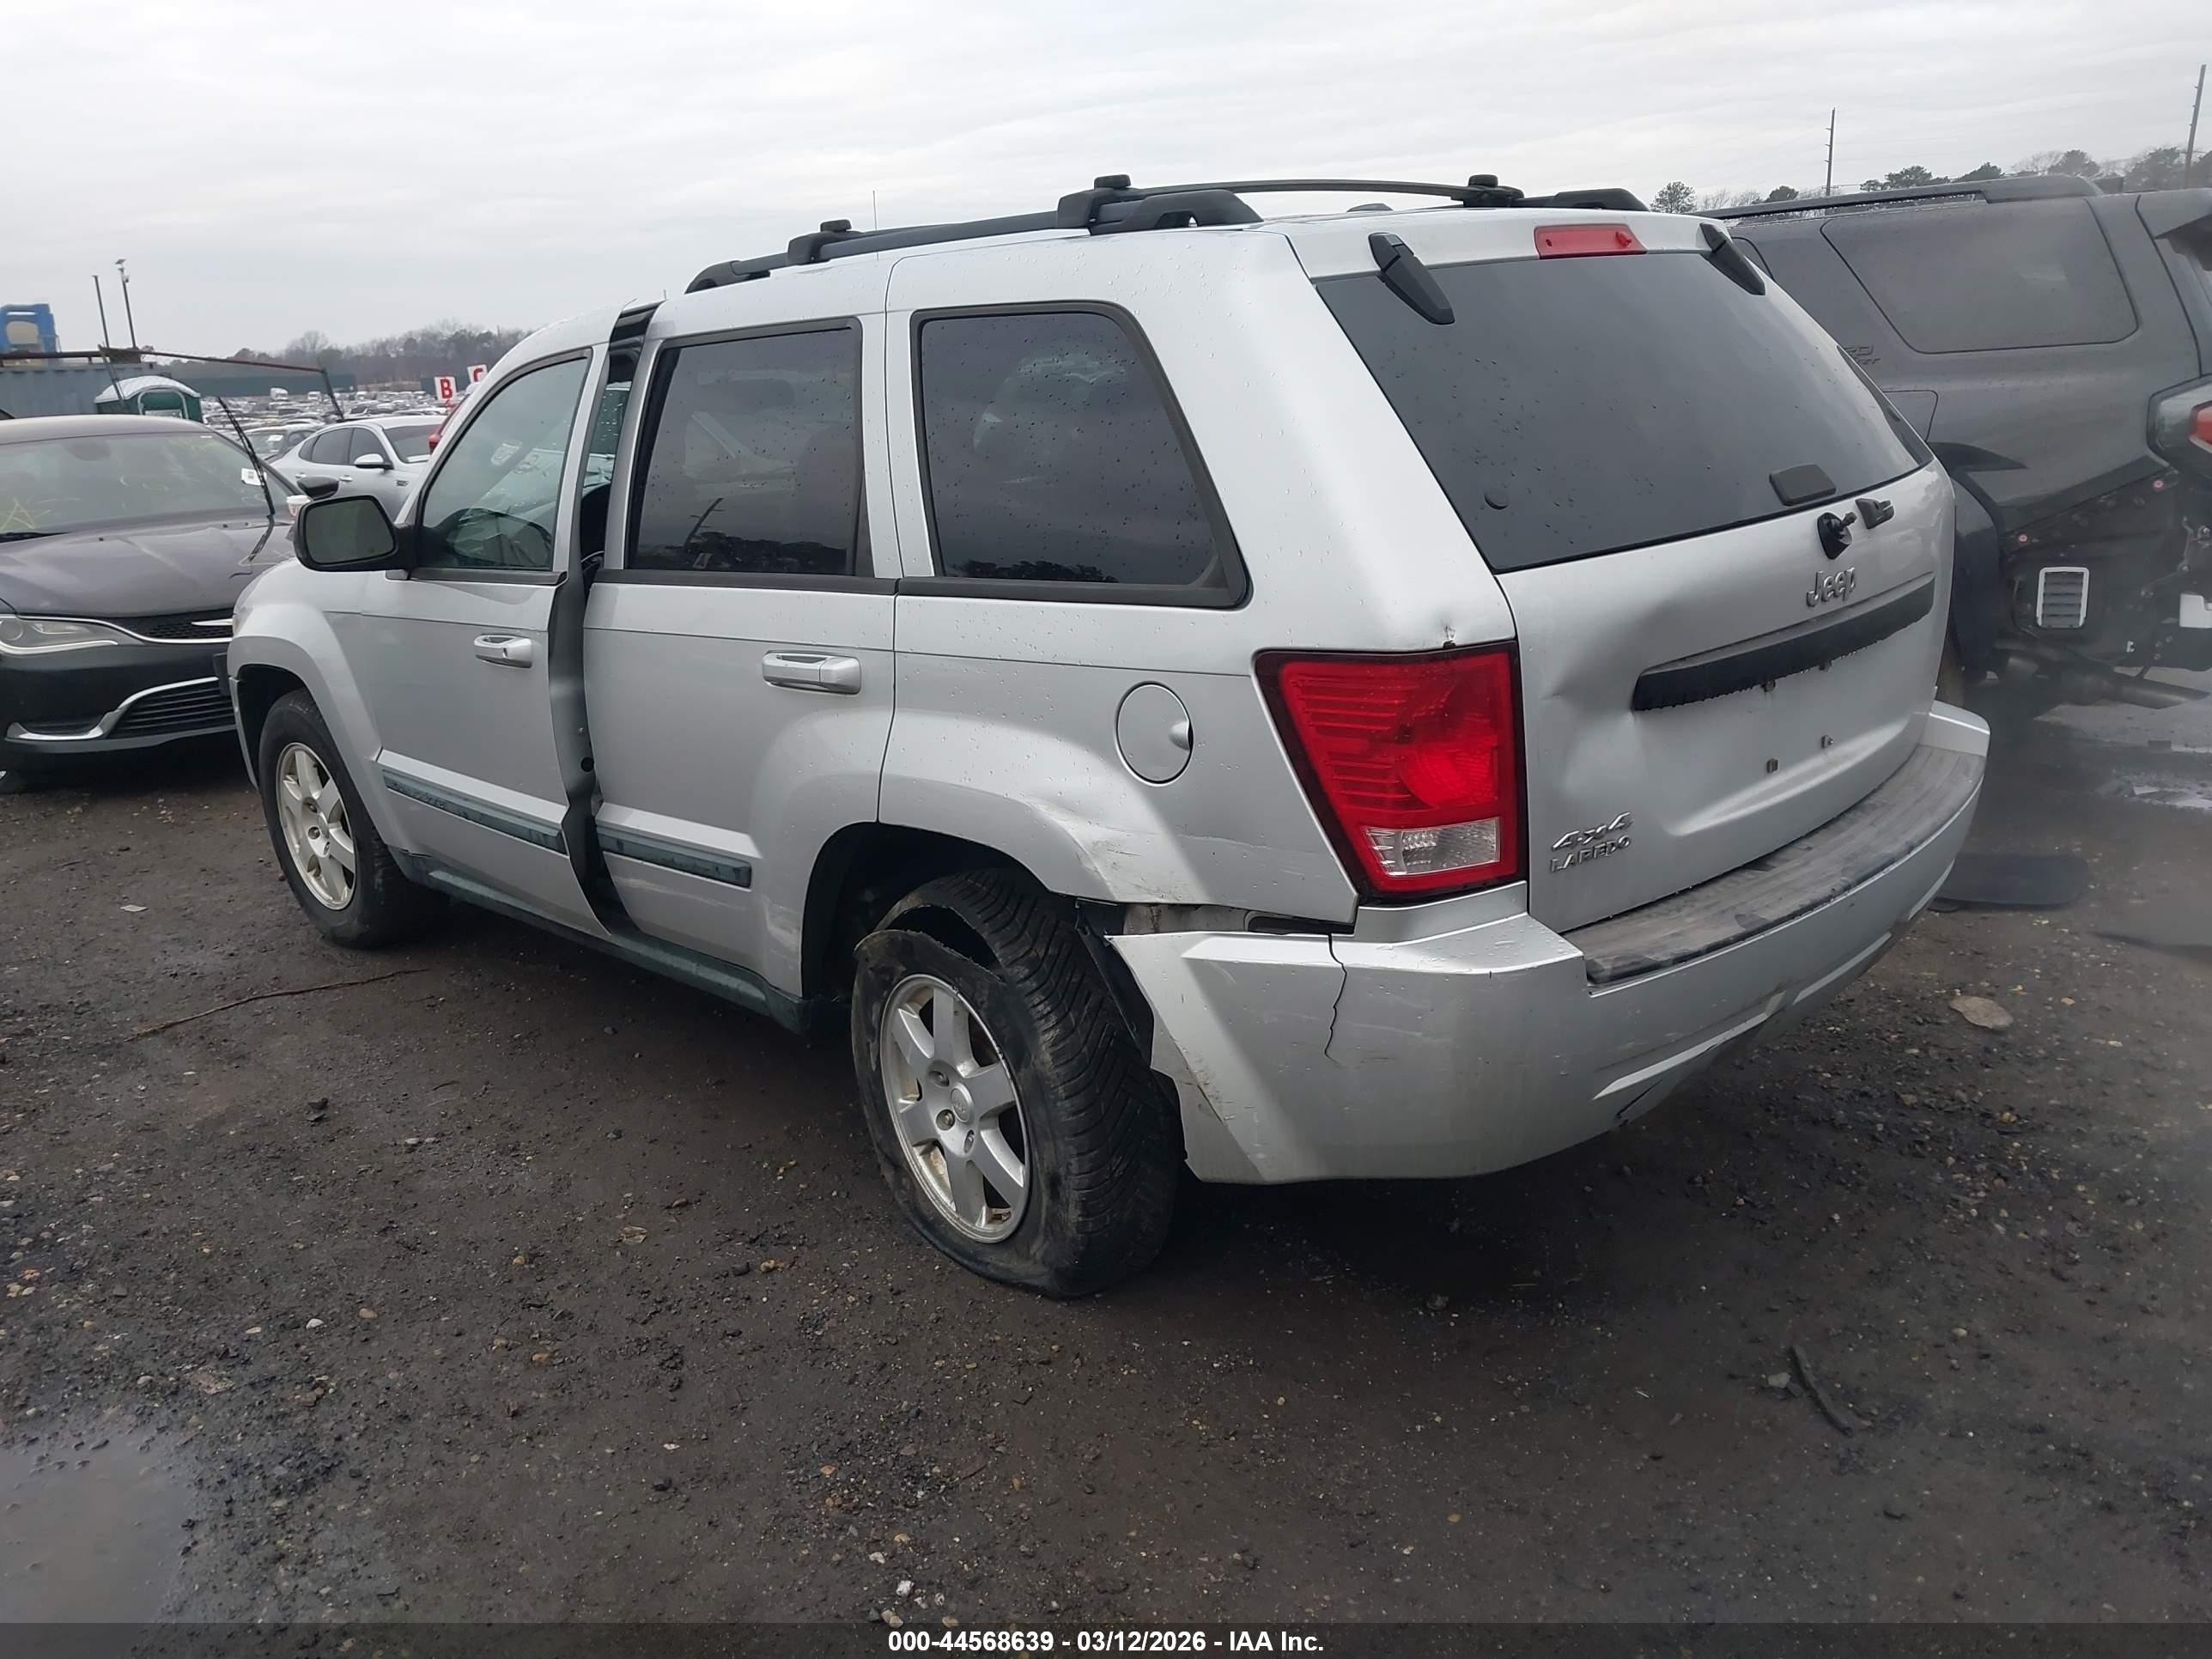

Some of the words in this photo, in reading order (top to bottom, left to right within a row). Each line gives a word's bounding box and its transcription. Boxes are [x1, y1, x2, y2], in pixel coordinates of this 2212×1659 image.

[440, 379, 453, 399] B
[1806, 567, 1856, 608] Jeep
[1550, 835, 1631, 872] LAREDO
